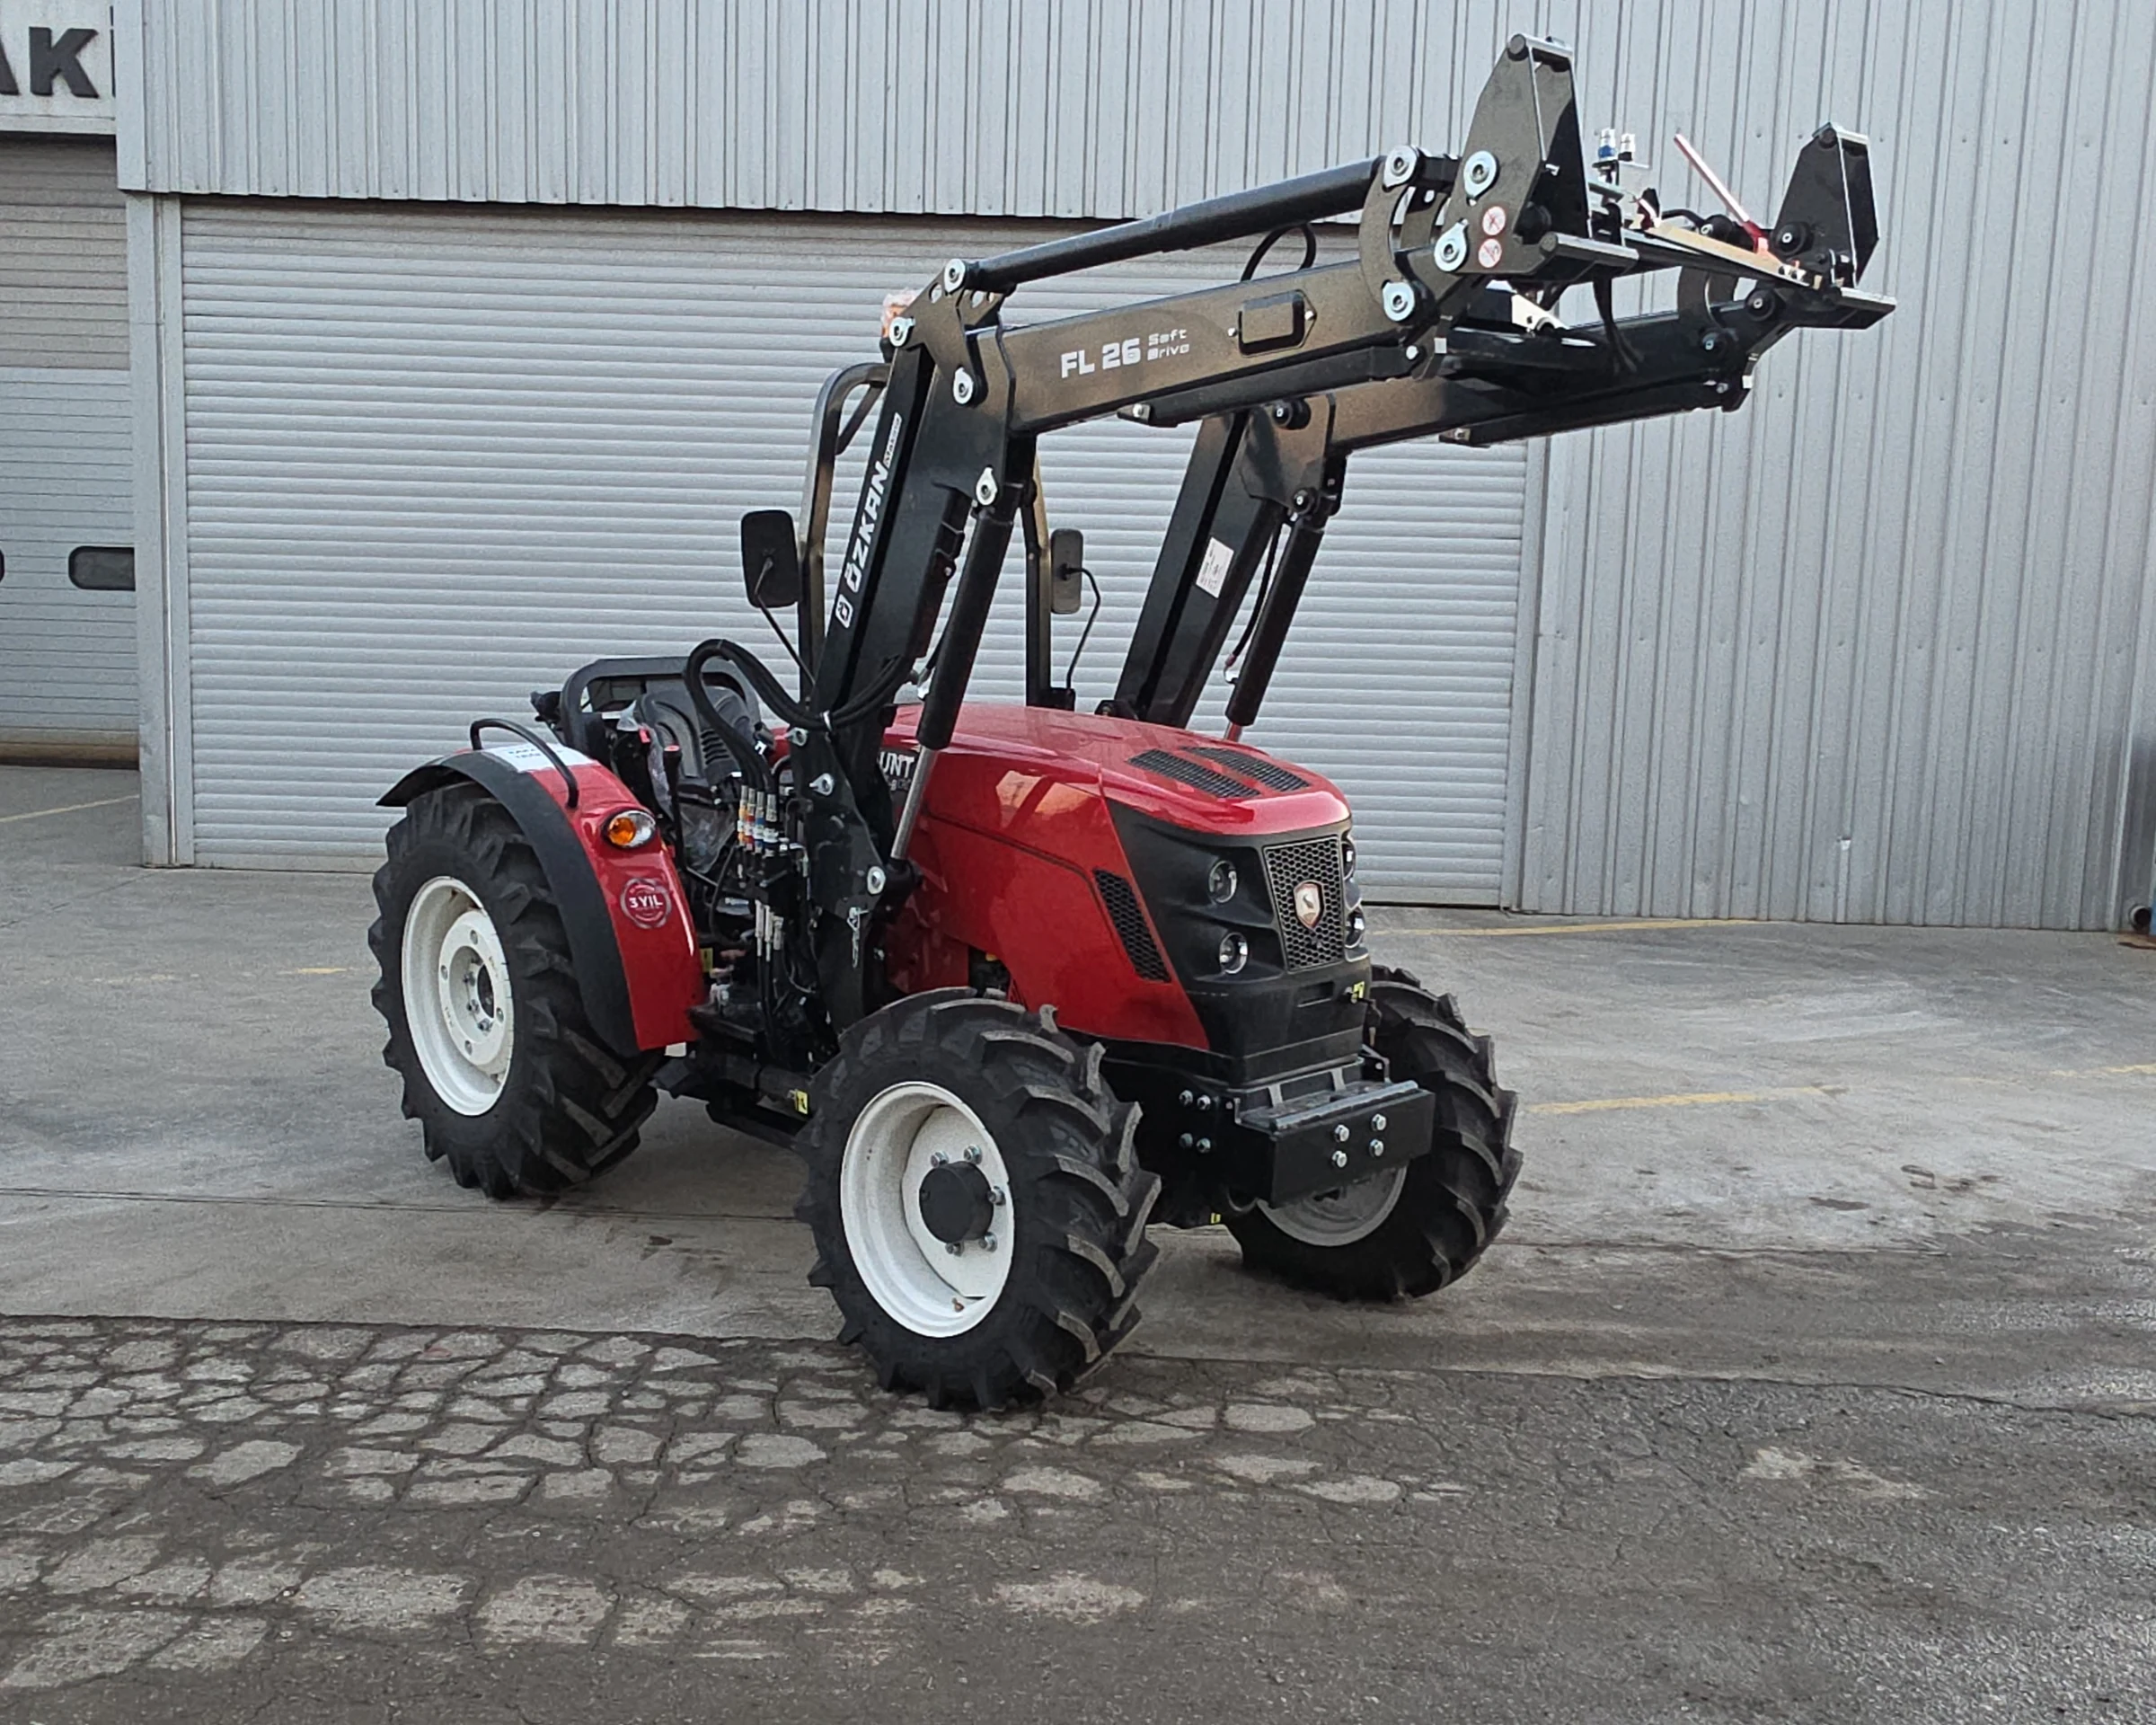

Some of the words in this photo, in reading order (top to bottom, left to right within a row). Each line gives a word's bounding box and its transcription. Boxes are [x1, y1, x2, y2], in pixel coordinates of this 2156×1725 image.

[1148, 329, 1188, 347] Soft
[1060, 349, 1095, 378] FL
[1102, 338, 1141, 369] 26
[1147, 343, 1190, 360] Drive
[844, 460, 891, 593] ÖZKAN
[879, 751, 915, 778] UNT
[629, 897, 638, 908] 3
[639, 895, 663, 907] YIL
